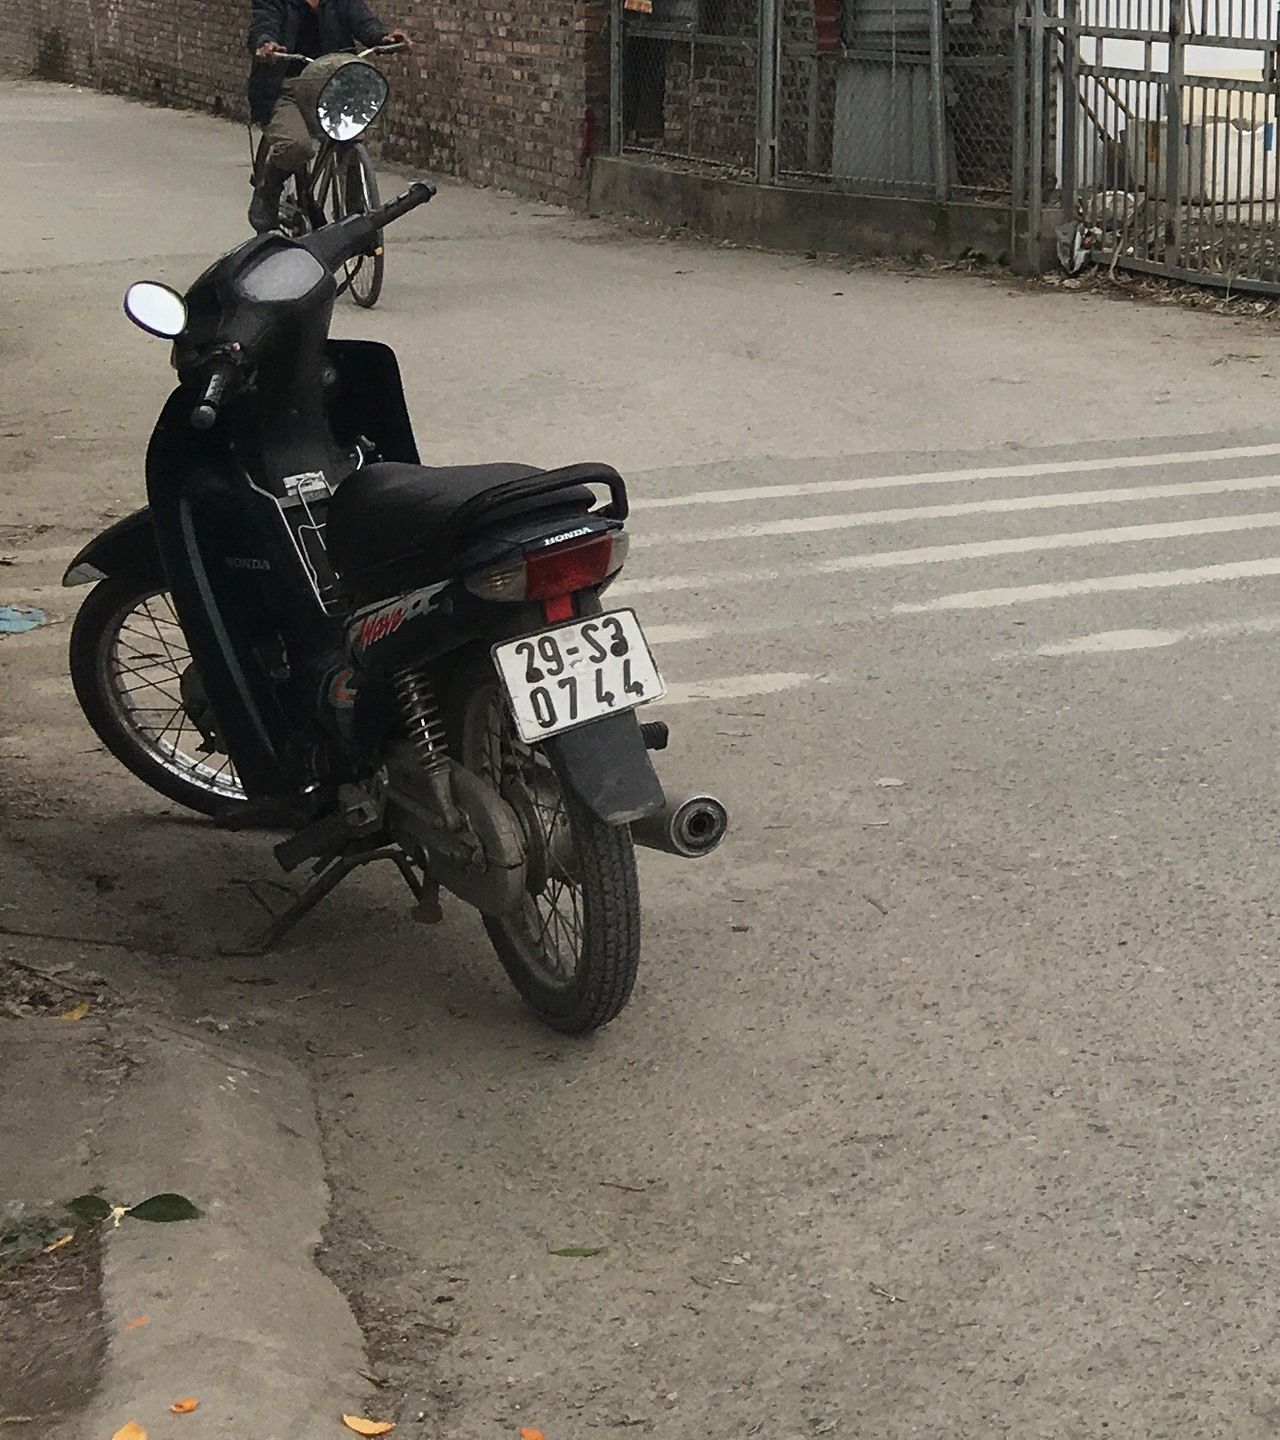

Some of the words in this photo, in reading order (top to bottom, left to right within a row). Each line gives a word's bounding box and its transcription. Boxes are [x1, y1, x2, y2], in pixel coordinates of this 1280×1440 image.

[543, 526, 593, 547] HONDA
[515, 617, 629, 684] 29-S3
[529, 658, 645, 729] 0744
